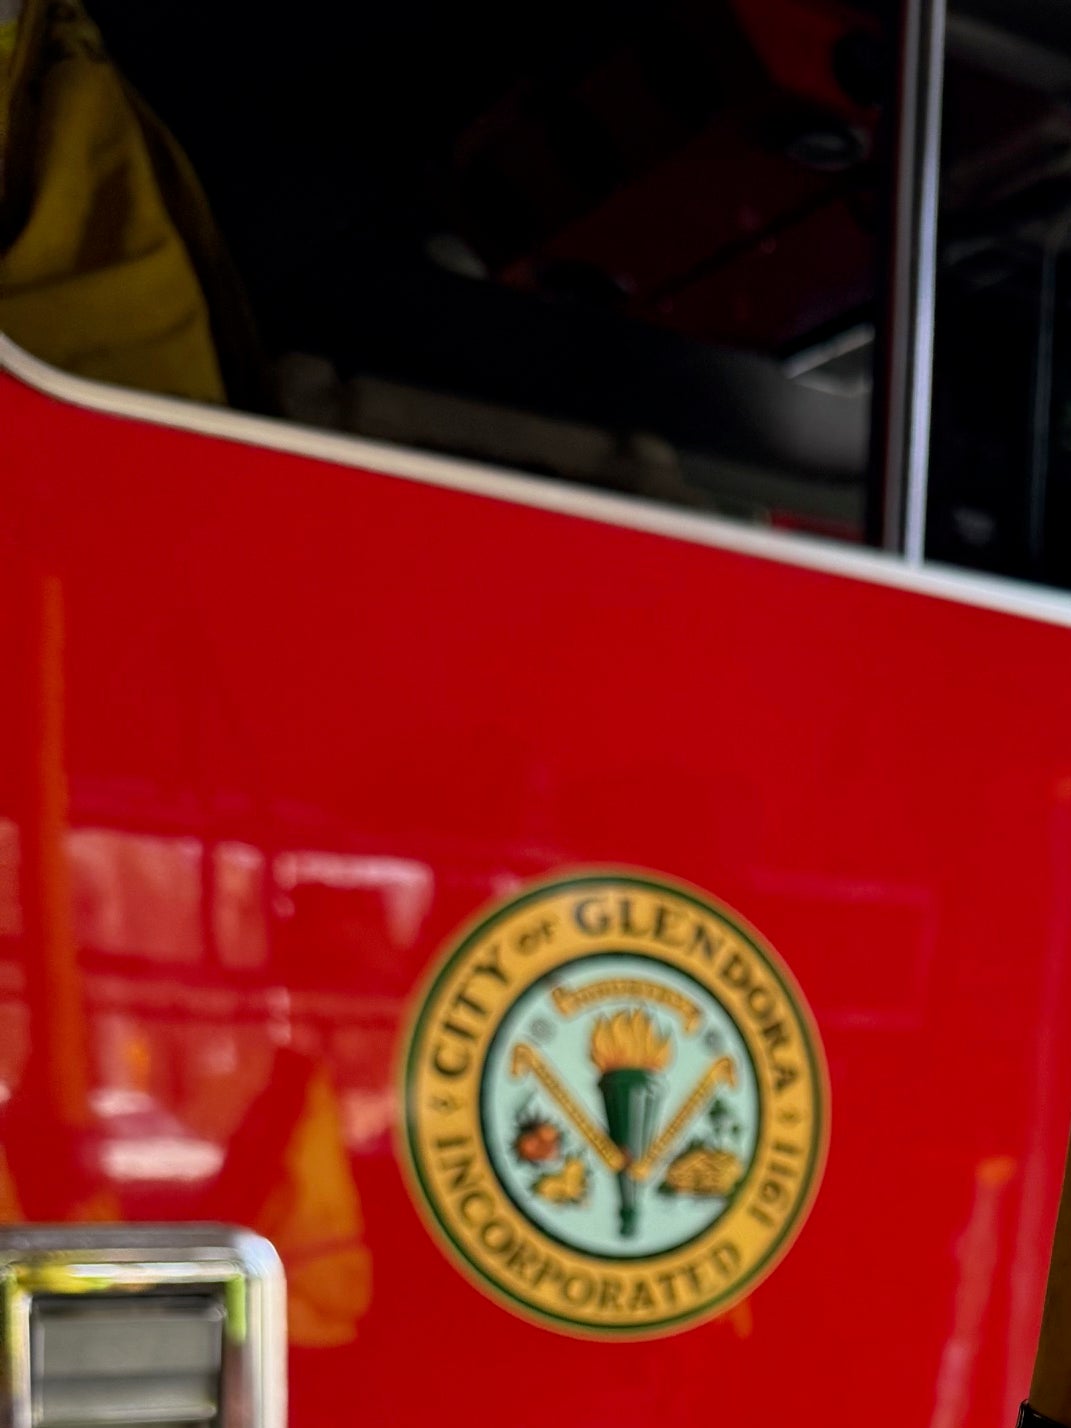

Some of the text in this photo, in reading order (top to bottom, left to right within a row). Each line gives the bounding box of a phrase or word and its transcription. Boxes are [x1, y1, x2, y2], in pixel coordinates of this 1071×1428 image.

[434, 959, 510, 1077] CITY
[573, 897, 797, 1092] GLENDORA
[436, 1136, 800, 1311] INCORPORATED 1911
